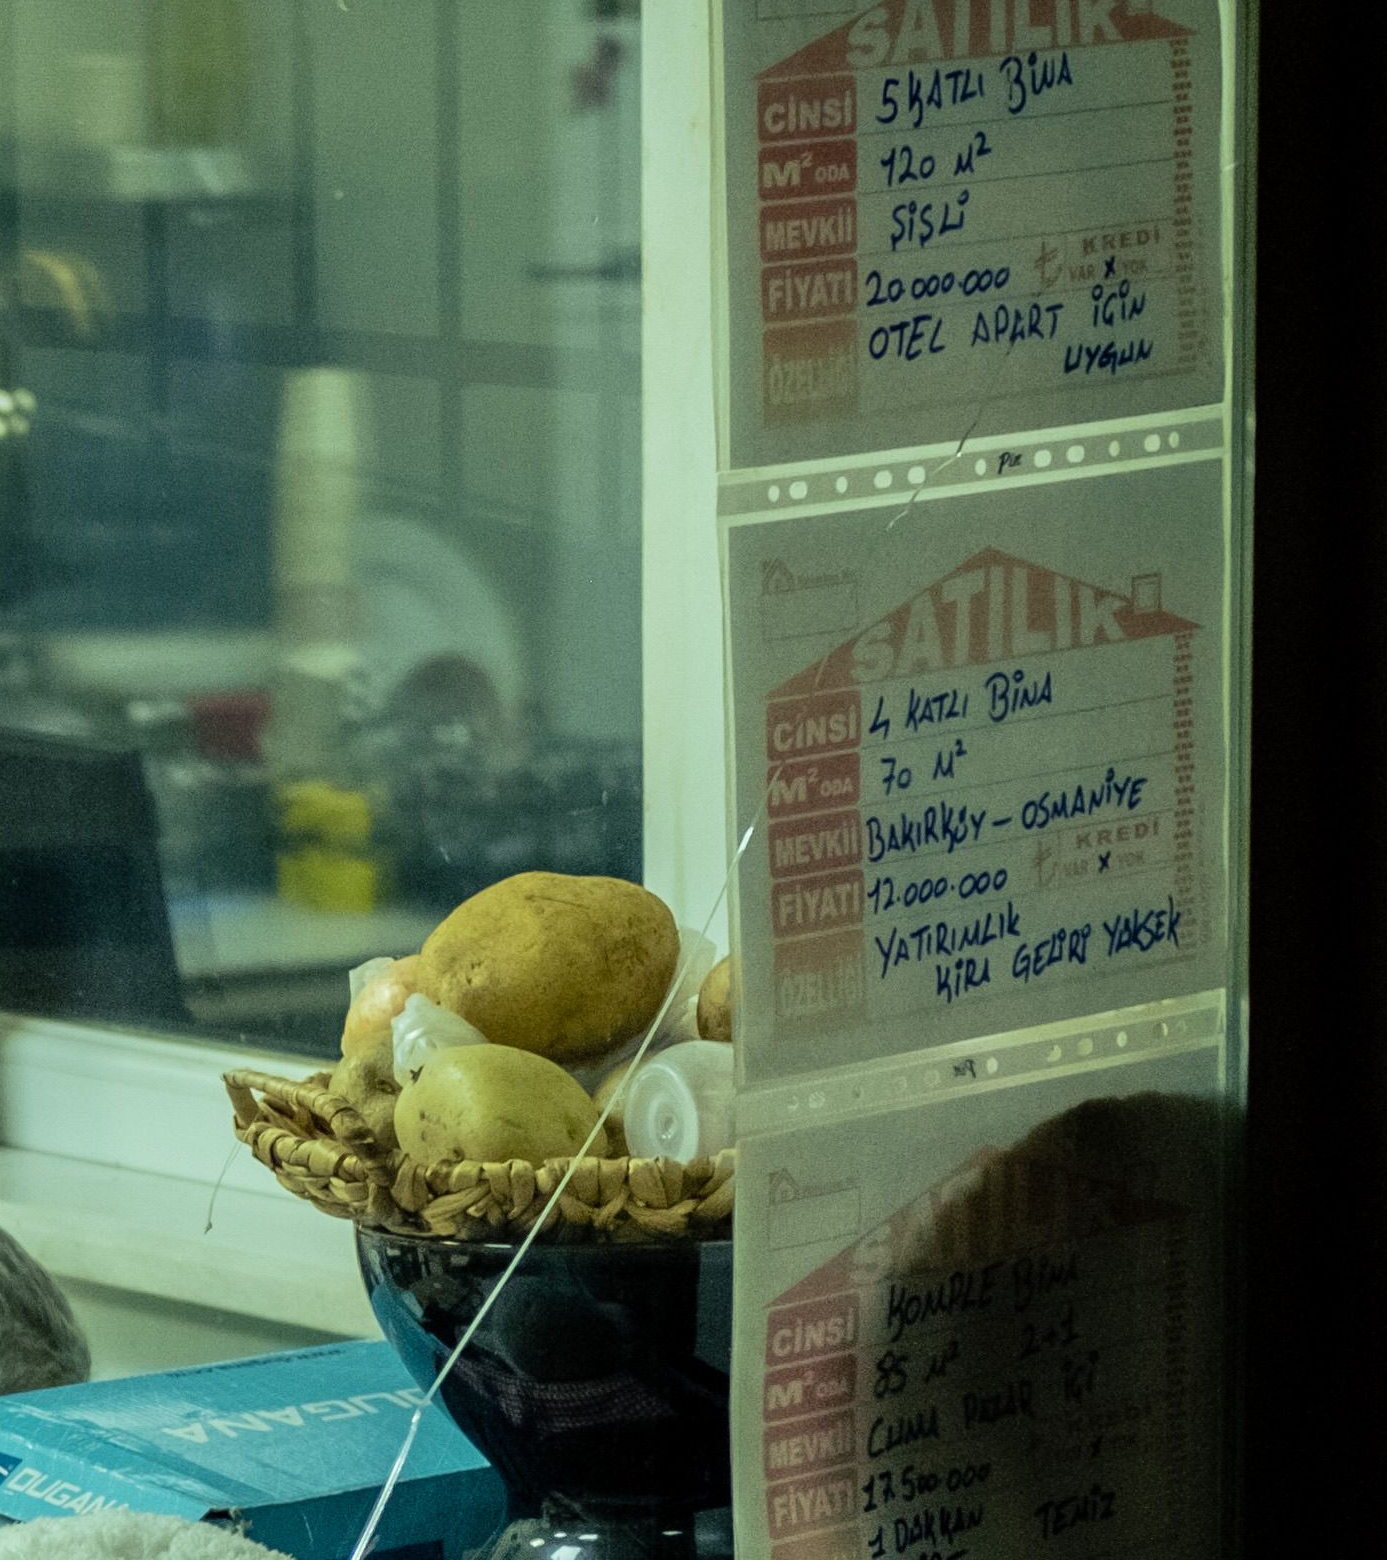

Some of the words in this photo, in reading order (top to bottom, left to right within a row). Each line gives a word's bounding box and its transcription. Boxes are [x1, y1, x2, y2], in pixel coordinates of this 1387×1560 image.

[763, 88, 853, 135] CİNSİ
[815, 163, 852, 184] ODA
[881, 145, 935, 188] 120
[767, 268, 854, 315] FİYATI
[868, 313, 947, 361] OTEL
[971, 303, 1065, 350] APART
[848, 564, 1128, 683] SATILIK
[904, 686, 970, 733] KATLI
[985, 668, 1053, 724] BİNA
[772, 702, 859, 753] CİNSİ
[776, 879, 861, 928] FİYATI
[866, 868, 1009, 915] 12.000.000
[771, 1306, 856, 1359] CİNSİ
[773, 1480, 855, 1529] FİYATI
